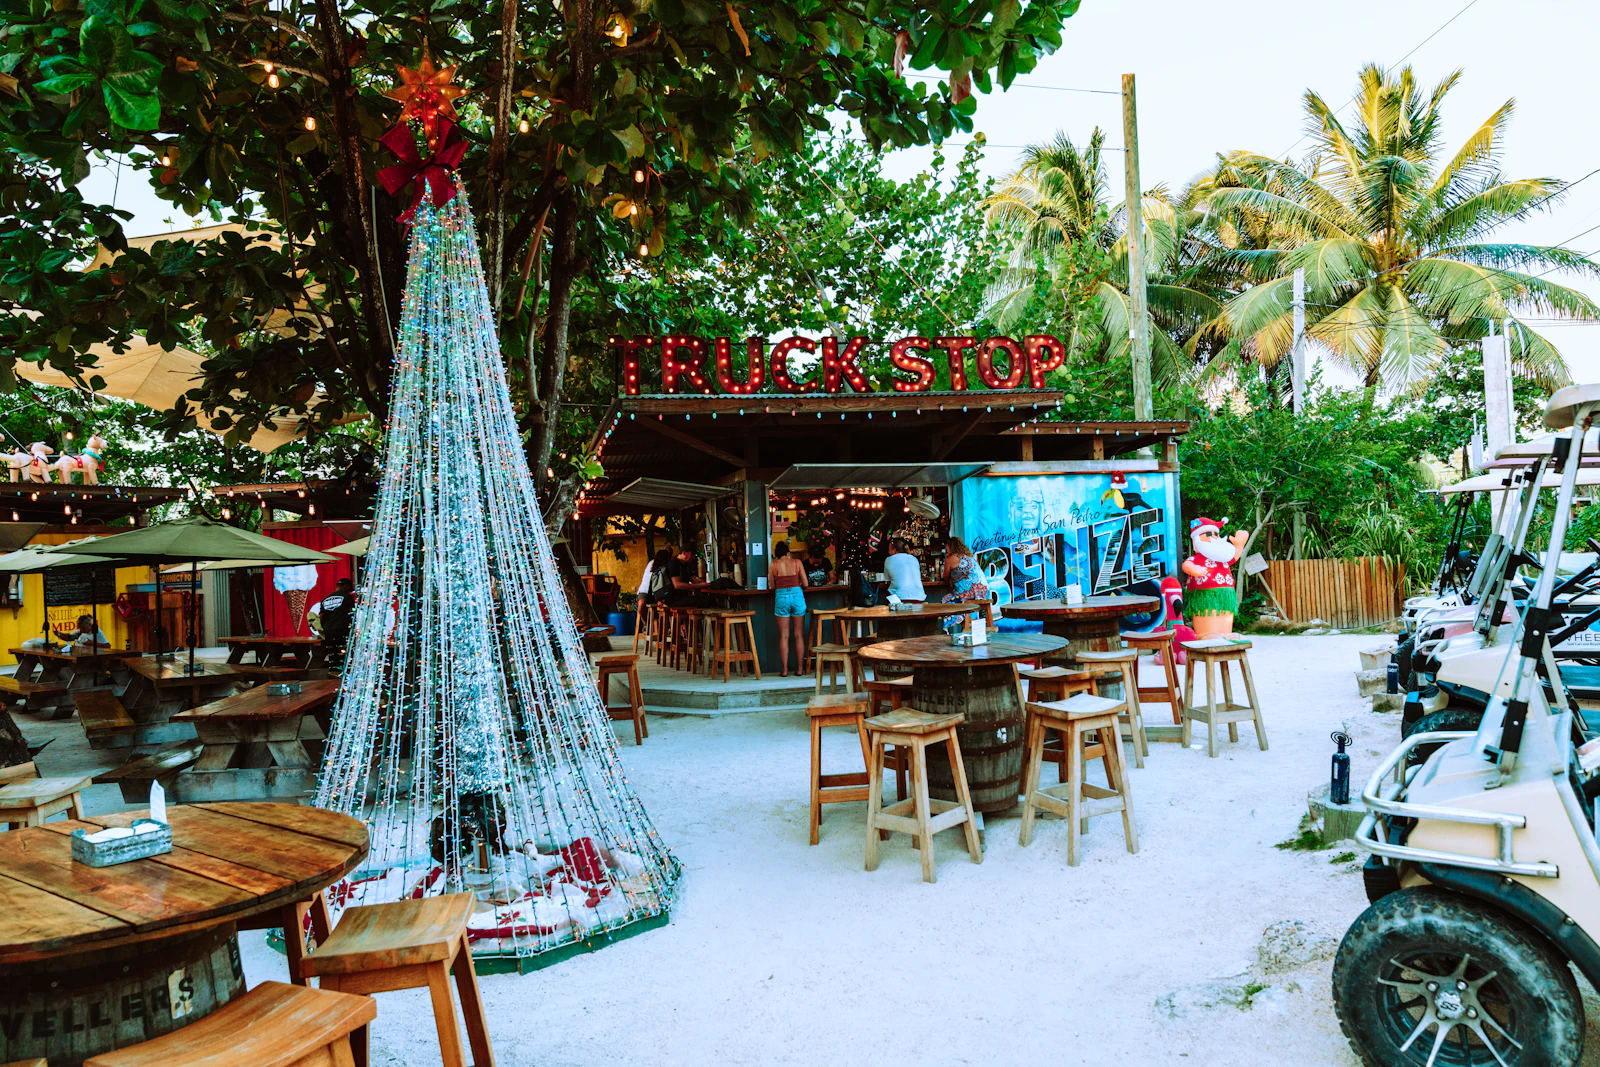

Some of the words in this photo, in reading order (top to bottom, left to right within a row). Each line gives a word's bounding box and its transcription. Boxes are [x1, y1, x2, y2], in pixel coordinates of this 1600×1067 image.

[608, 335, 874, 395] TRUCK
[890, 335, 1064, 391] STOP
[972, 531, 1016, 553] Greetings
[1018, 526, 1040, 543] from
[1042, 514, 1066, 535] San
[1070, 507, 1100, 526] Pedro
[974, 508, 1163, 621] BELIZE
